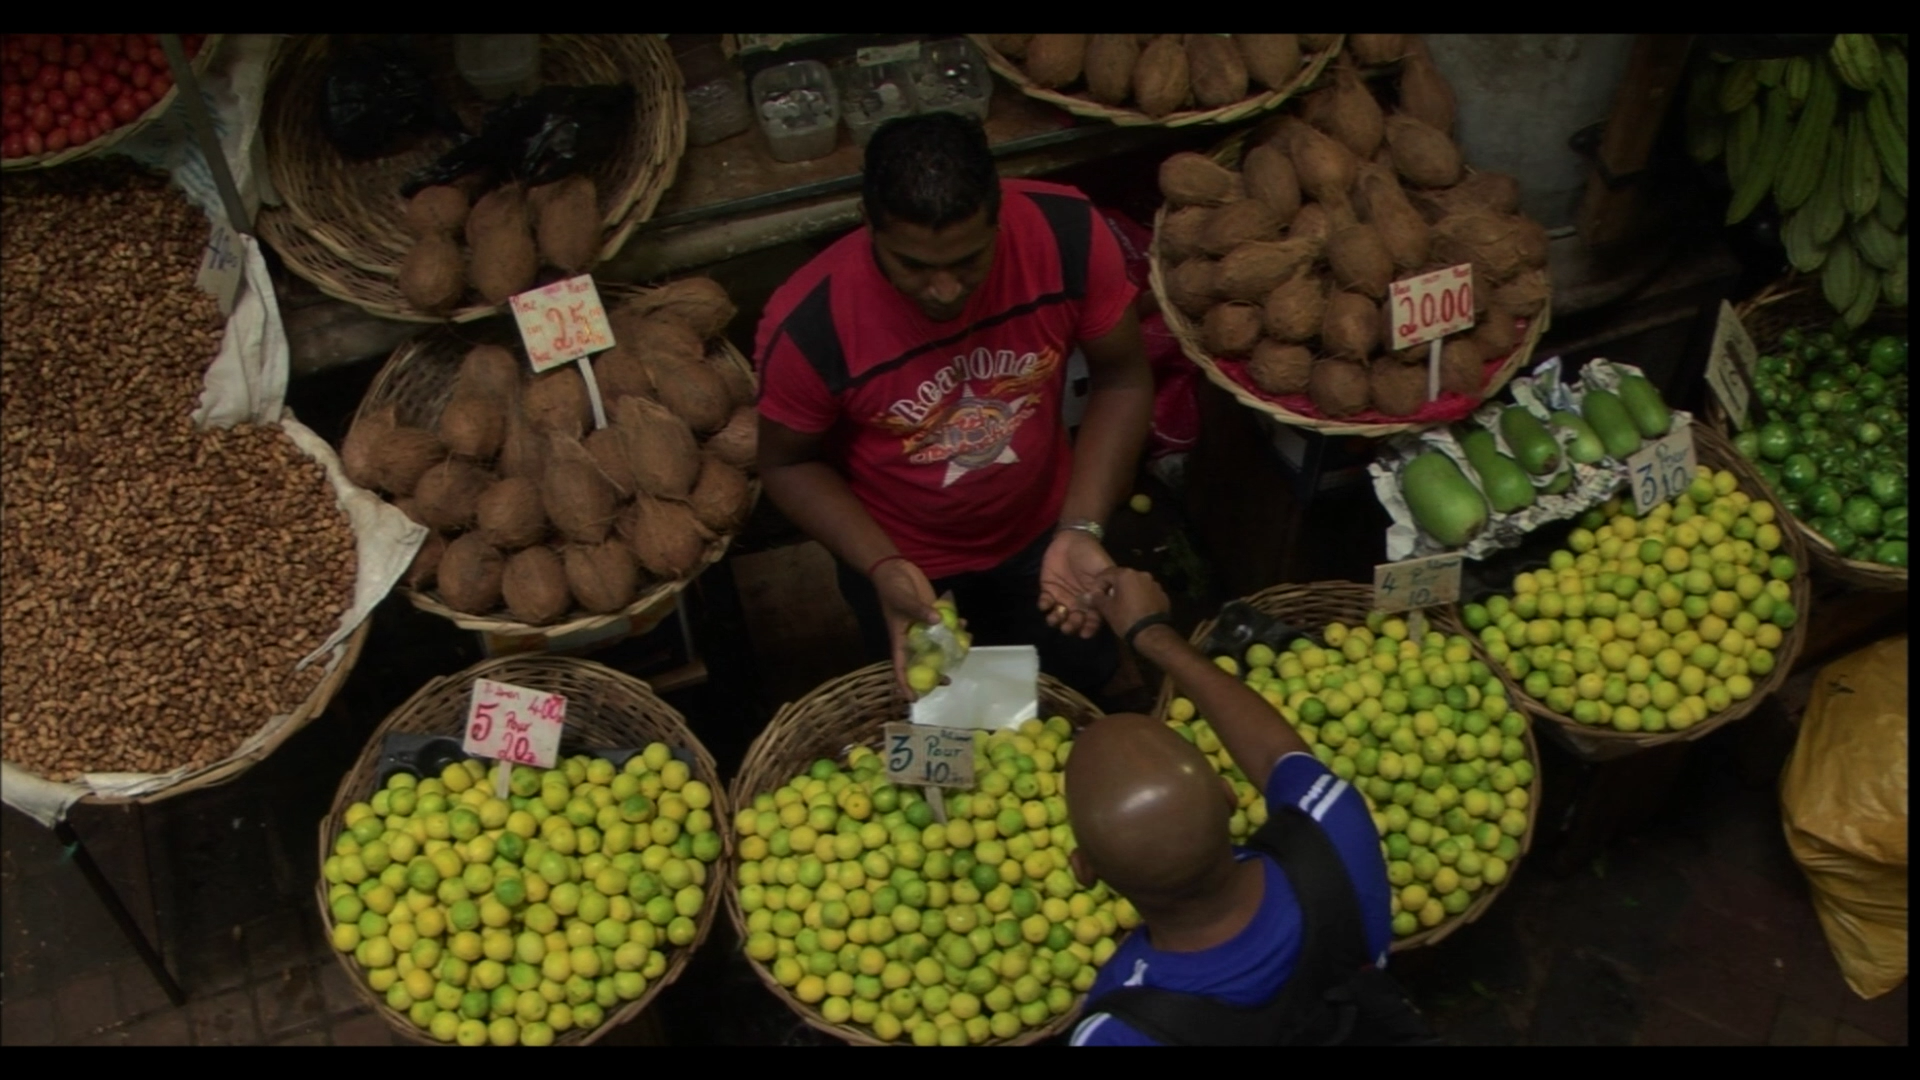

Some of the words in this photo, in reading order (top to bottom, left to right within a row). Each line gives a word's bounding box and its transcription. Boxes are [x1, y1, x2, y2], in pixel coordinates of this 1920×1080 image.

[1382, 571, 1397, 596] 4
[471, 701, 500, 742] 5
[889, 734, 914, 773] 3
